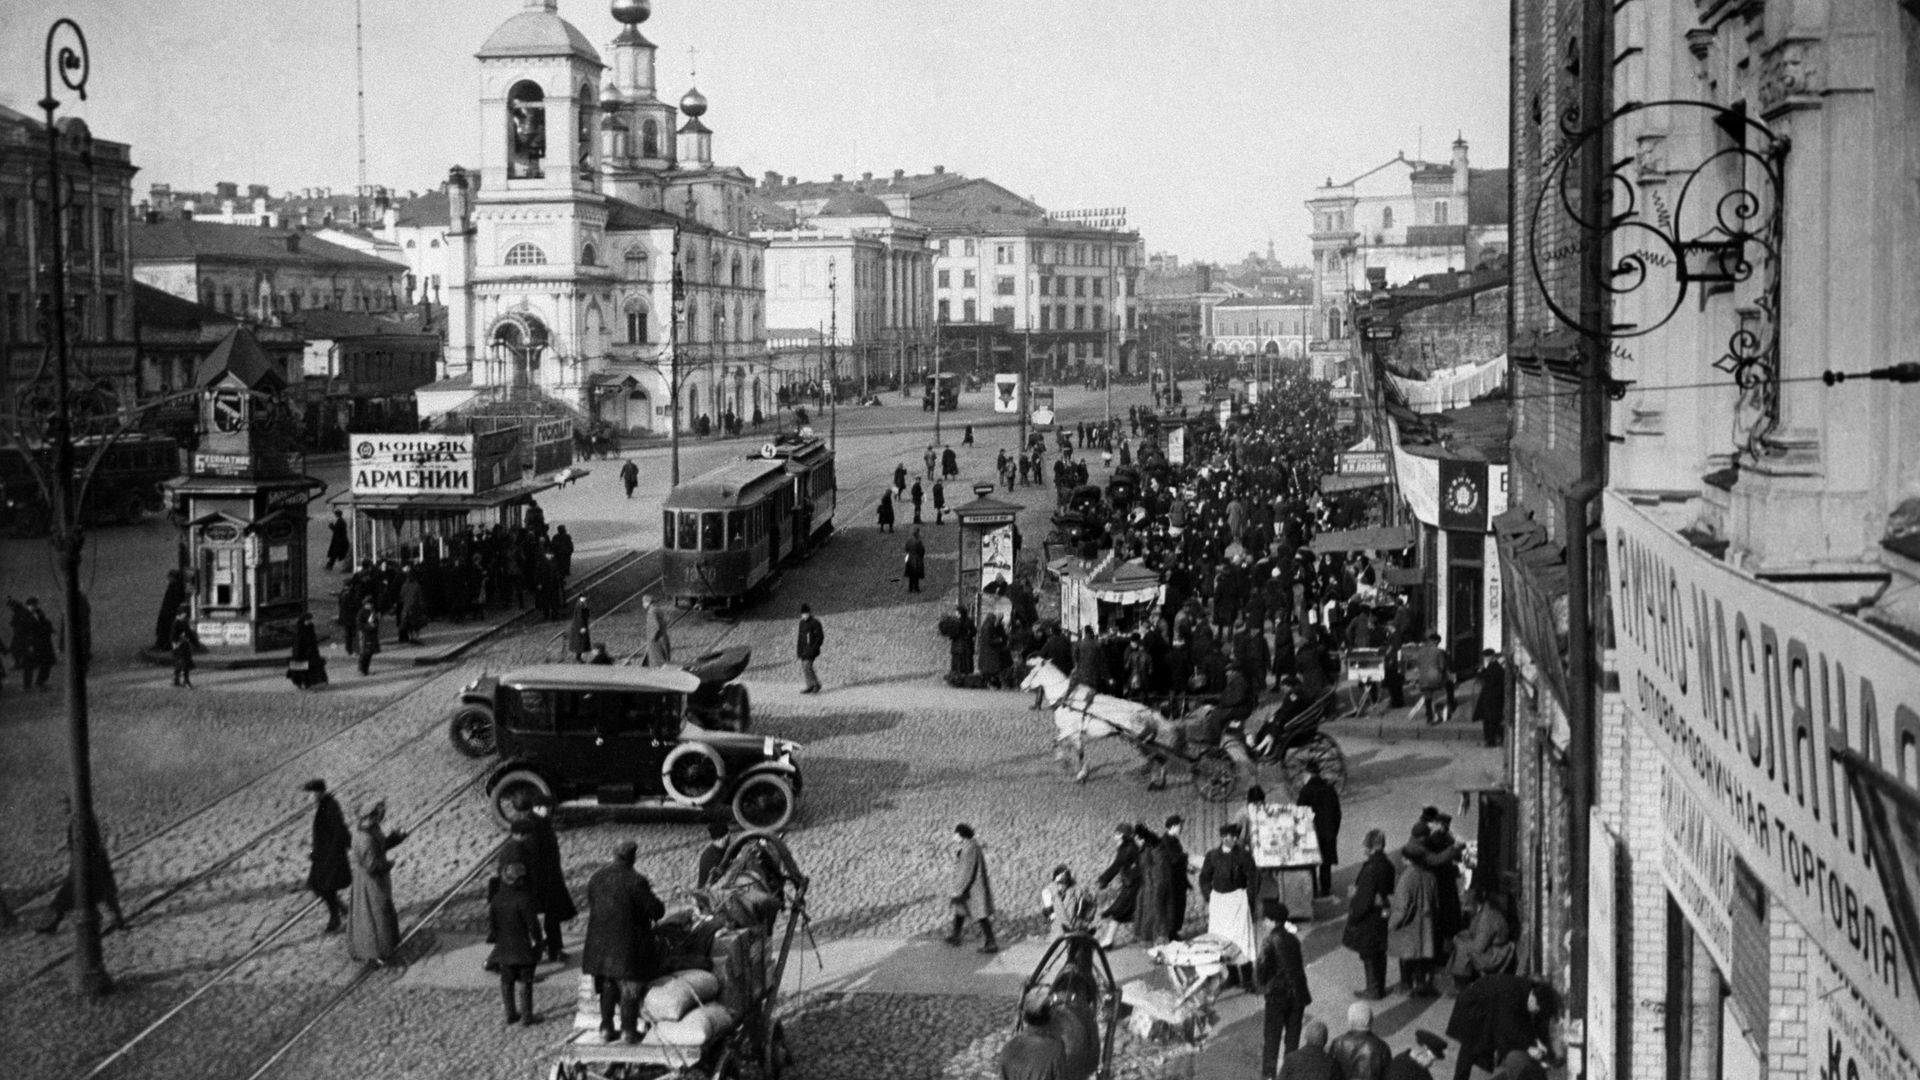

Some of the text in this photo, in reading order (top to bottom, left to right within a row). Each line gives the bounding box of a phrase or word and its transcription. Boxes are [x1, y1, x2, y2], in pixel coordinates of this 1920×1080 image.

[379, 442, 467, 453] КОНЬЯК
[356, 470, 468, 489] АРМЕНИИ
[1637, 669, 1770, 857] ОПТОВО-РОЗНИЧНАЯ
[1775, 818, 1899, 1000] ТОРГОВЛЯ
